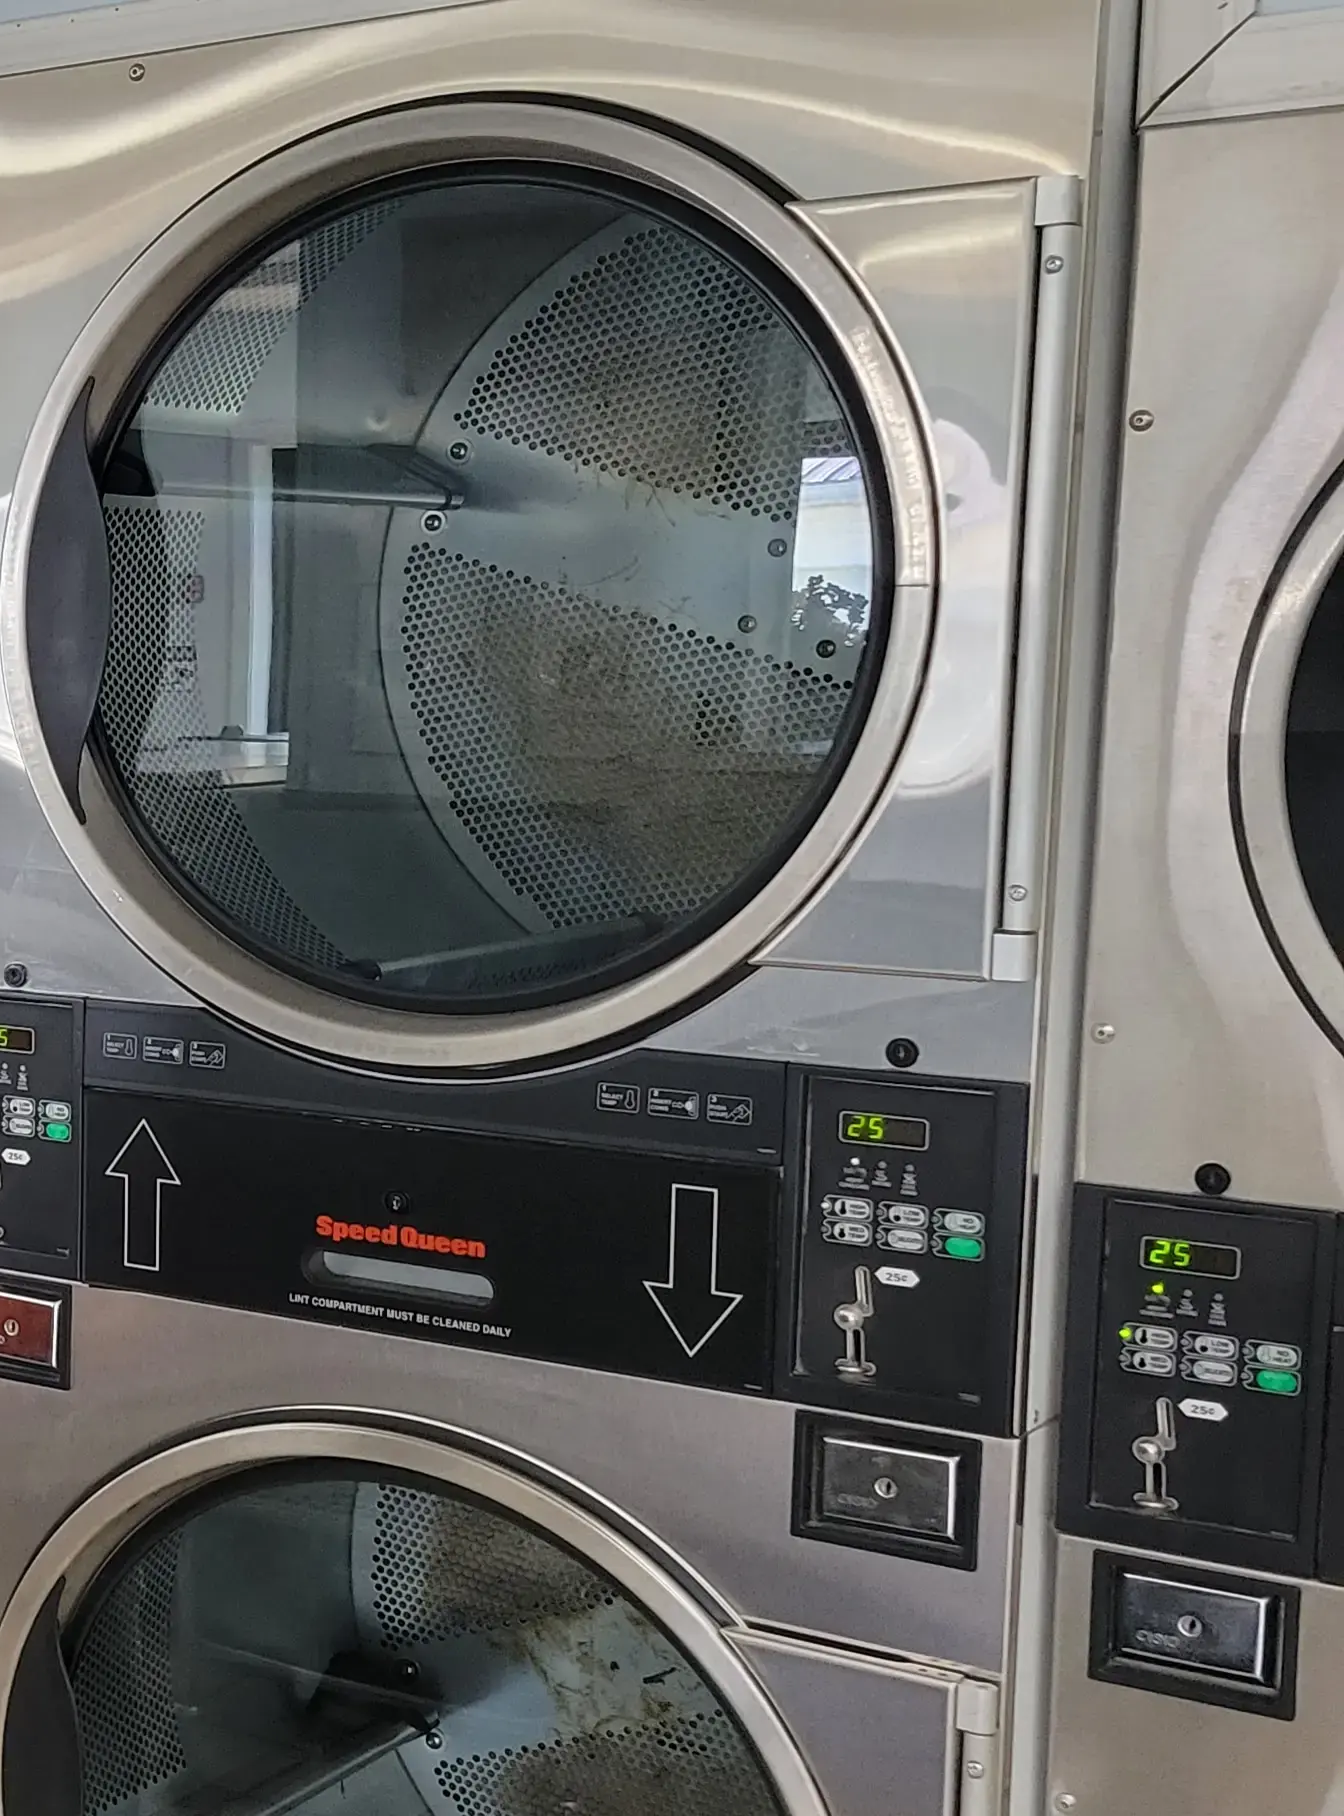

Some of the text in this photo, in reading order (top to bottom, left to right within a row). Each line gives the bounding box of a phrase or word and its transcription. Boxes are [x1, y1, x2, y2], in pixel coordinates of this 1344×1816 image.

[847, 1115, 885, 1139] 25
[316, 1215, 486, 1258] Speed Queen
[1149, 1240, 1192, 1267] 25
[884, 1271, 909, 1283] 25¢
[289, 1292, 512, 1338] LINT COMPARTMENT MUST BE CLEANED DAILY
[1190, 1404, 1216, 1416] 25¢
